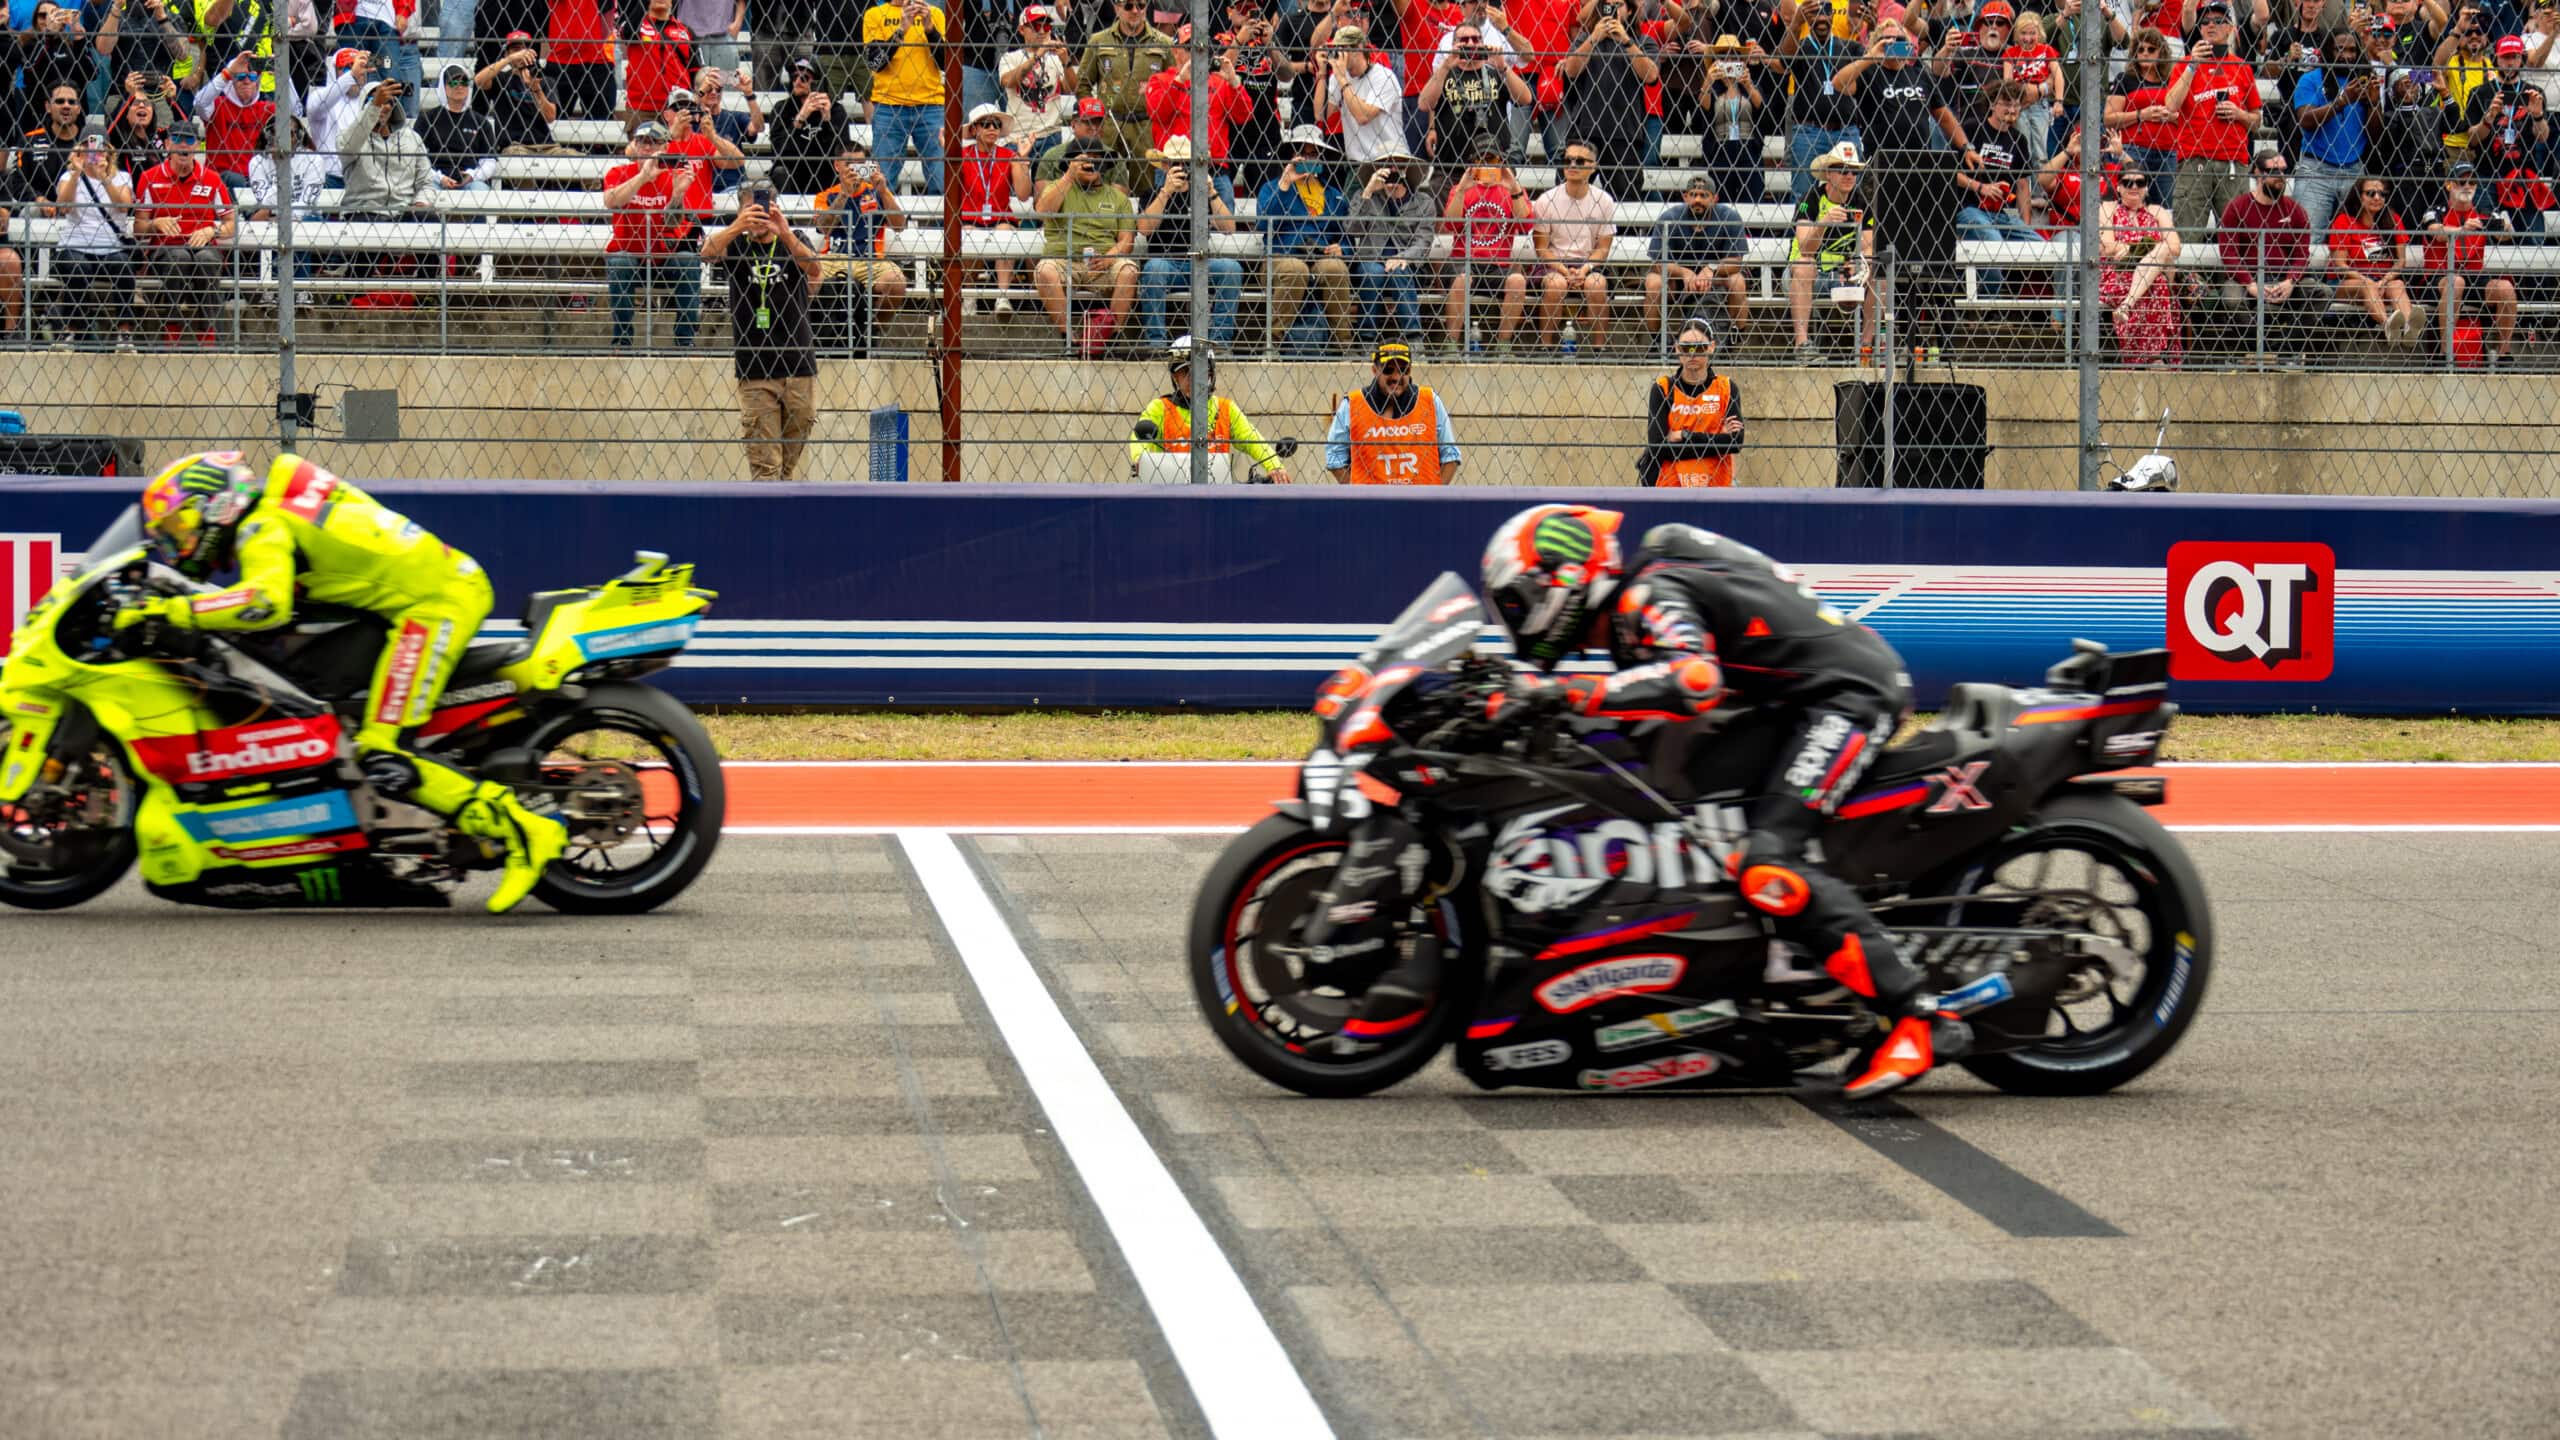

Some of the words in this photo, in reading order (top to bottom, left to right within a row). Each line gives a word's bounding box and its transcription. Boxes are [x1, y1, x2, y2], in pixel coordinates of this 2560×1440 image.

[191, 184, 212, 197] 93
[1377, 452, 1419, 476] TR
[2184, 560, 2310, 662] QT
[186, 739, 328, 774] Enduro
